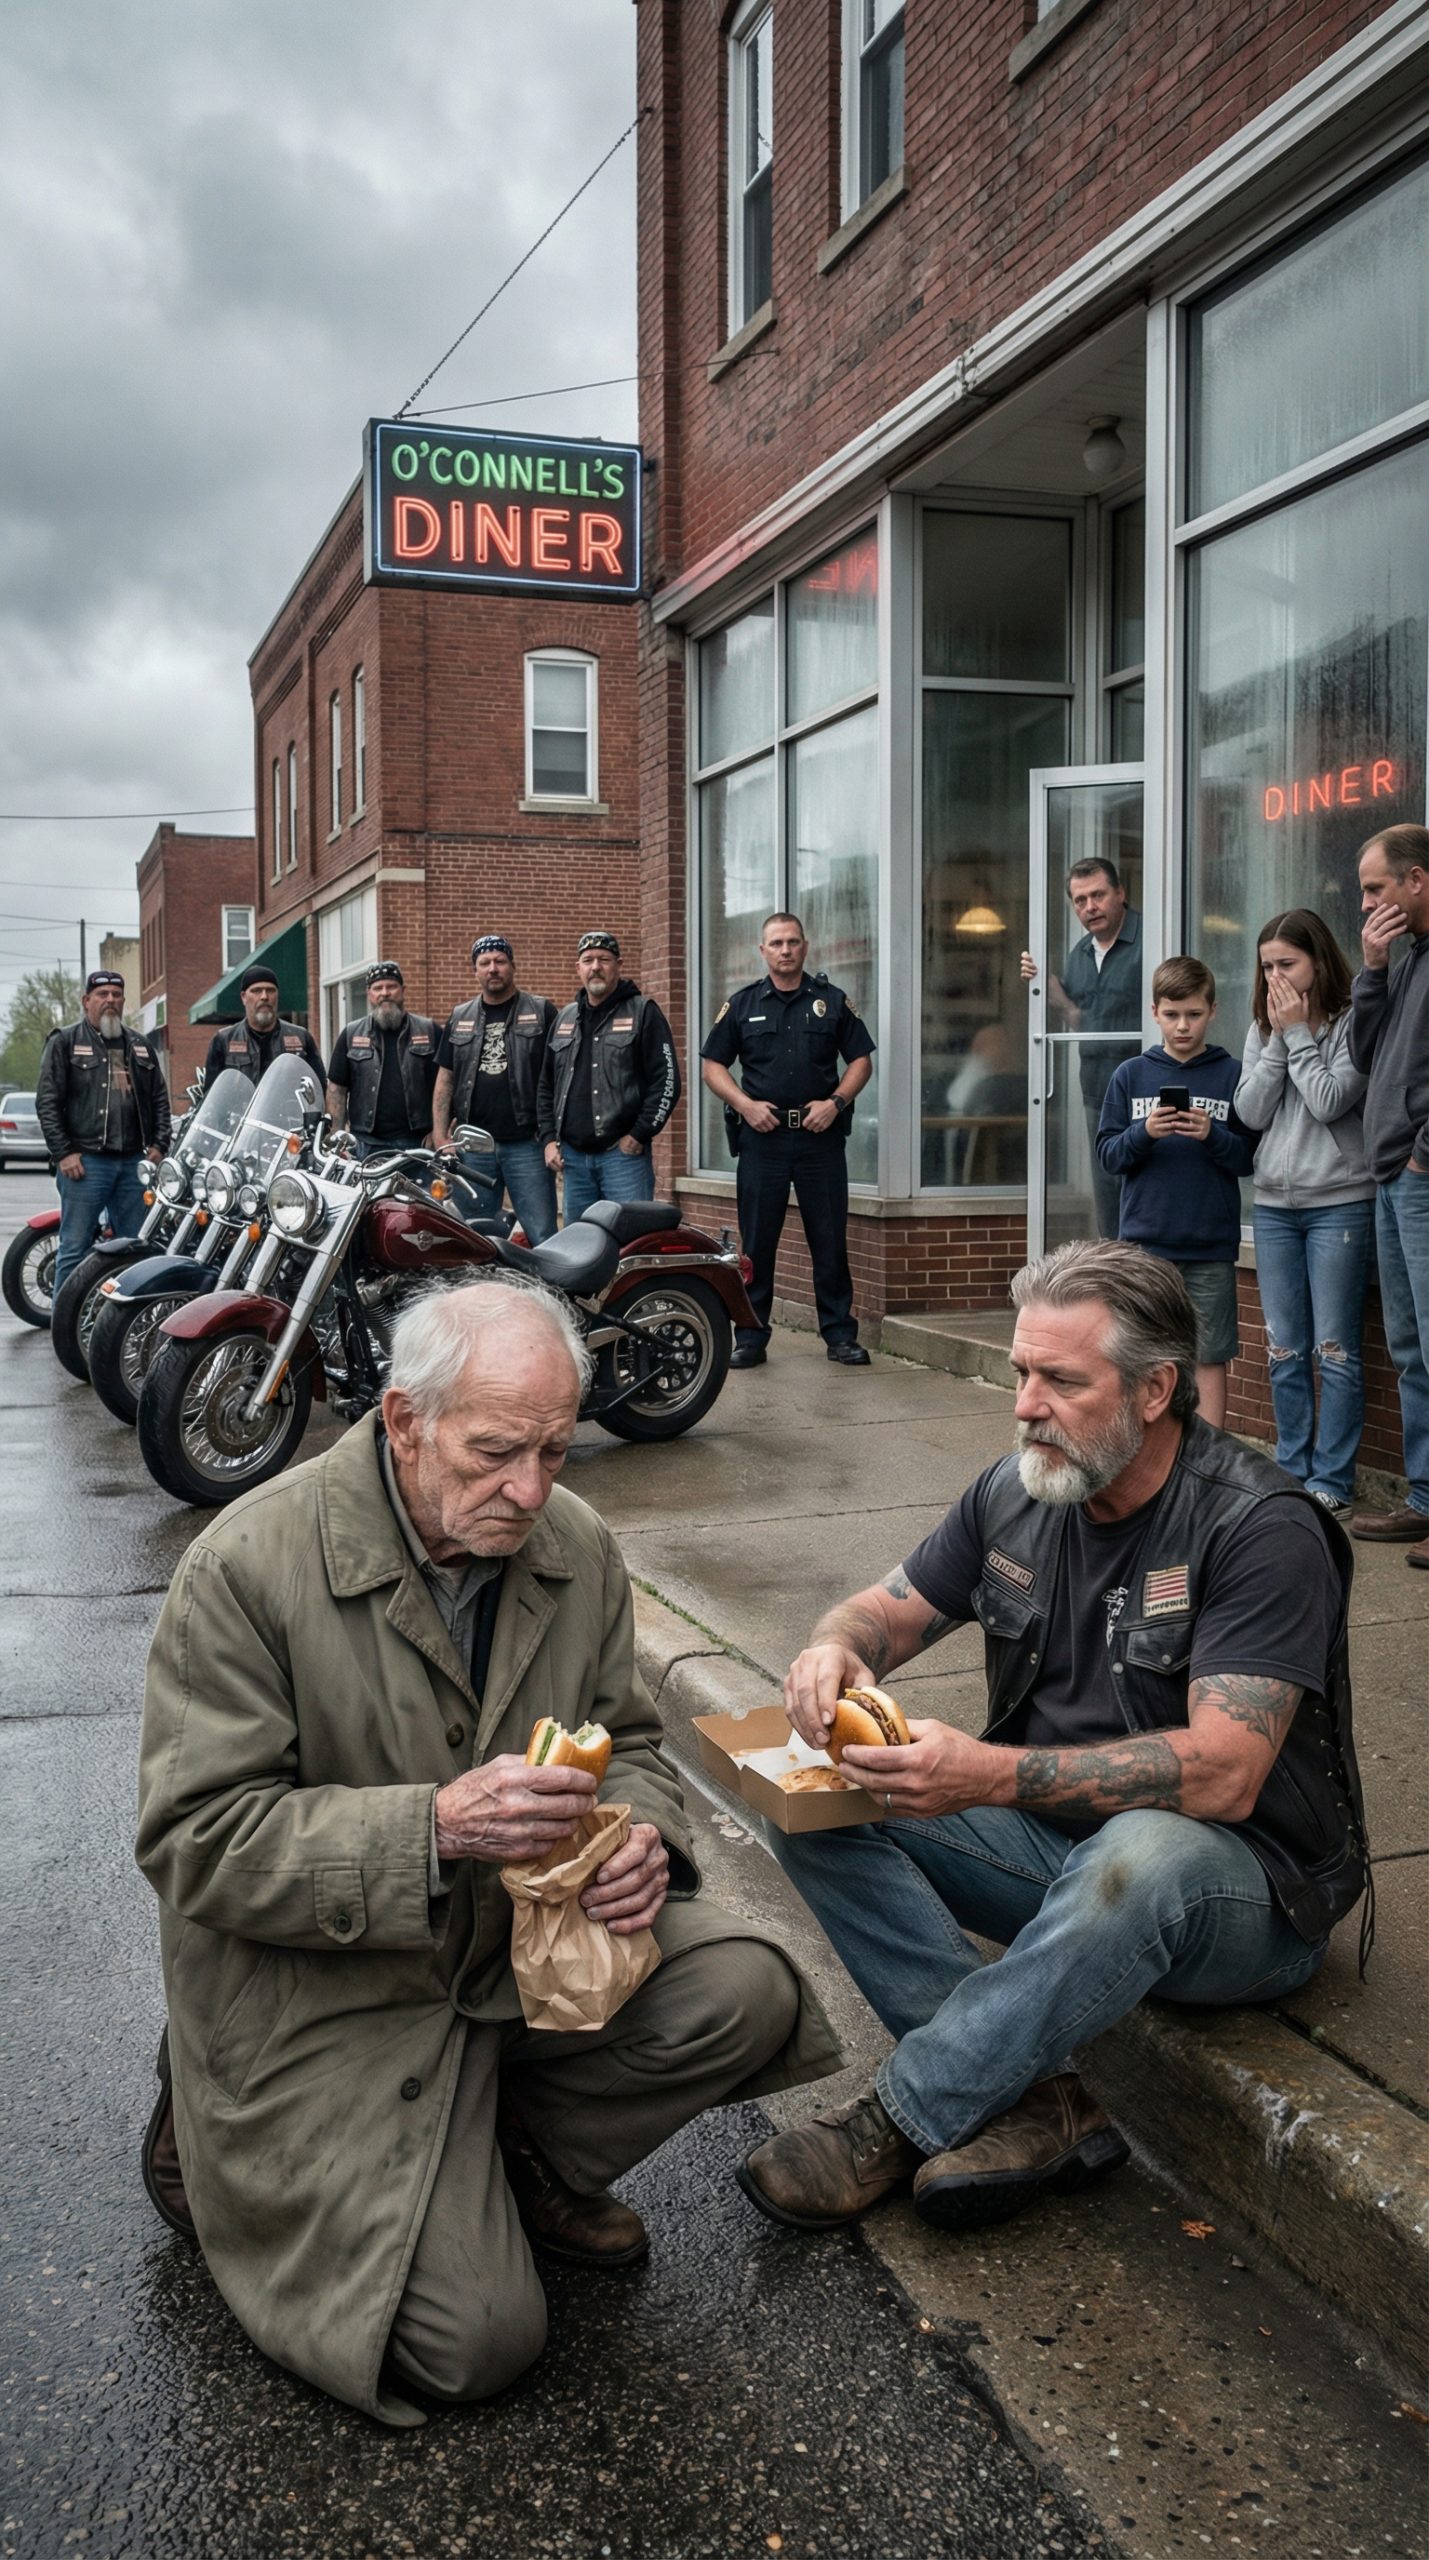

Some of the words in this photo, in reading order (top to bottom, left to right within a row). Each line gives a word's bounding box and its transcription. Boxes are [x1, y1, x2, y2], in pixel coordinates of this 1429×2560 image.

[391, 440, 625, 500] O'CONNELL'S
[393, 495, 624, 576] DINER
[1263, 758, 1396, 822] DINER
